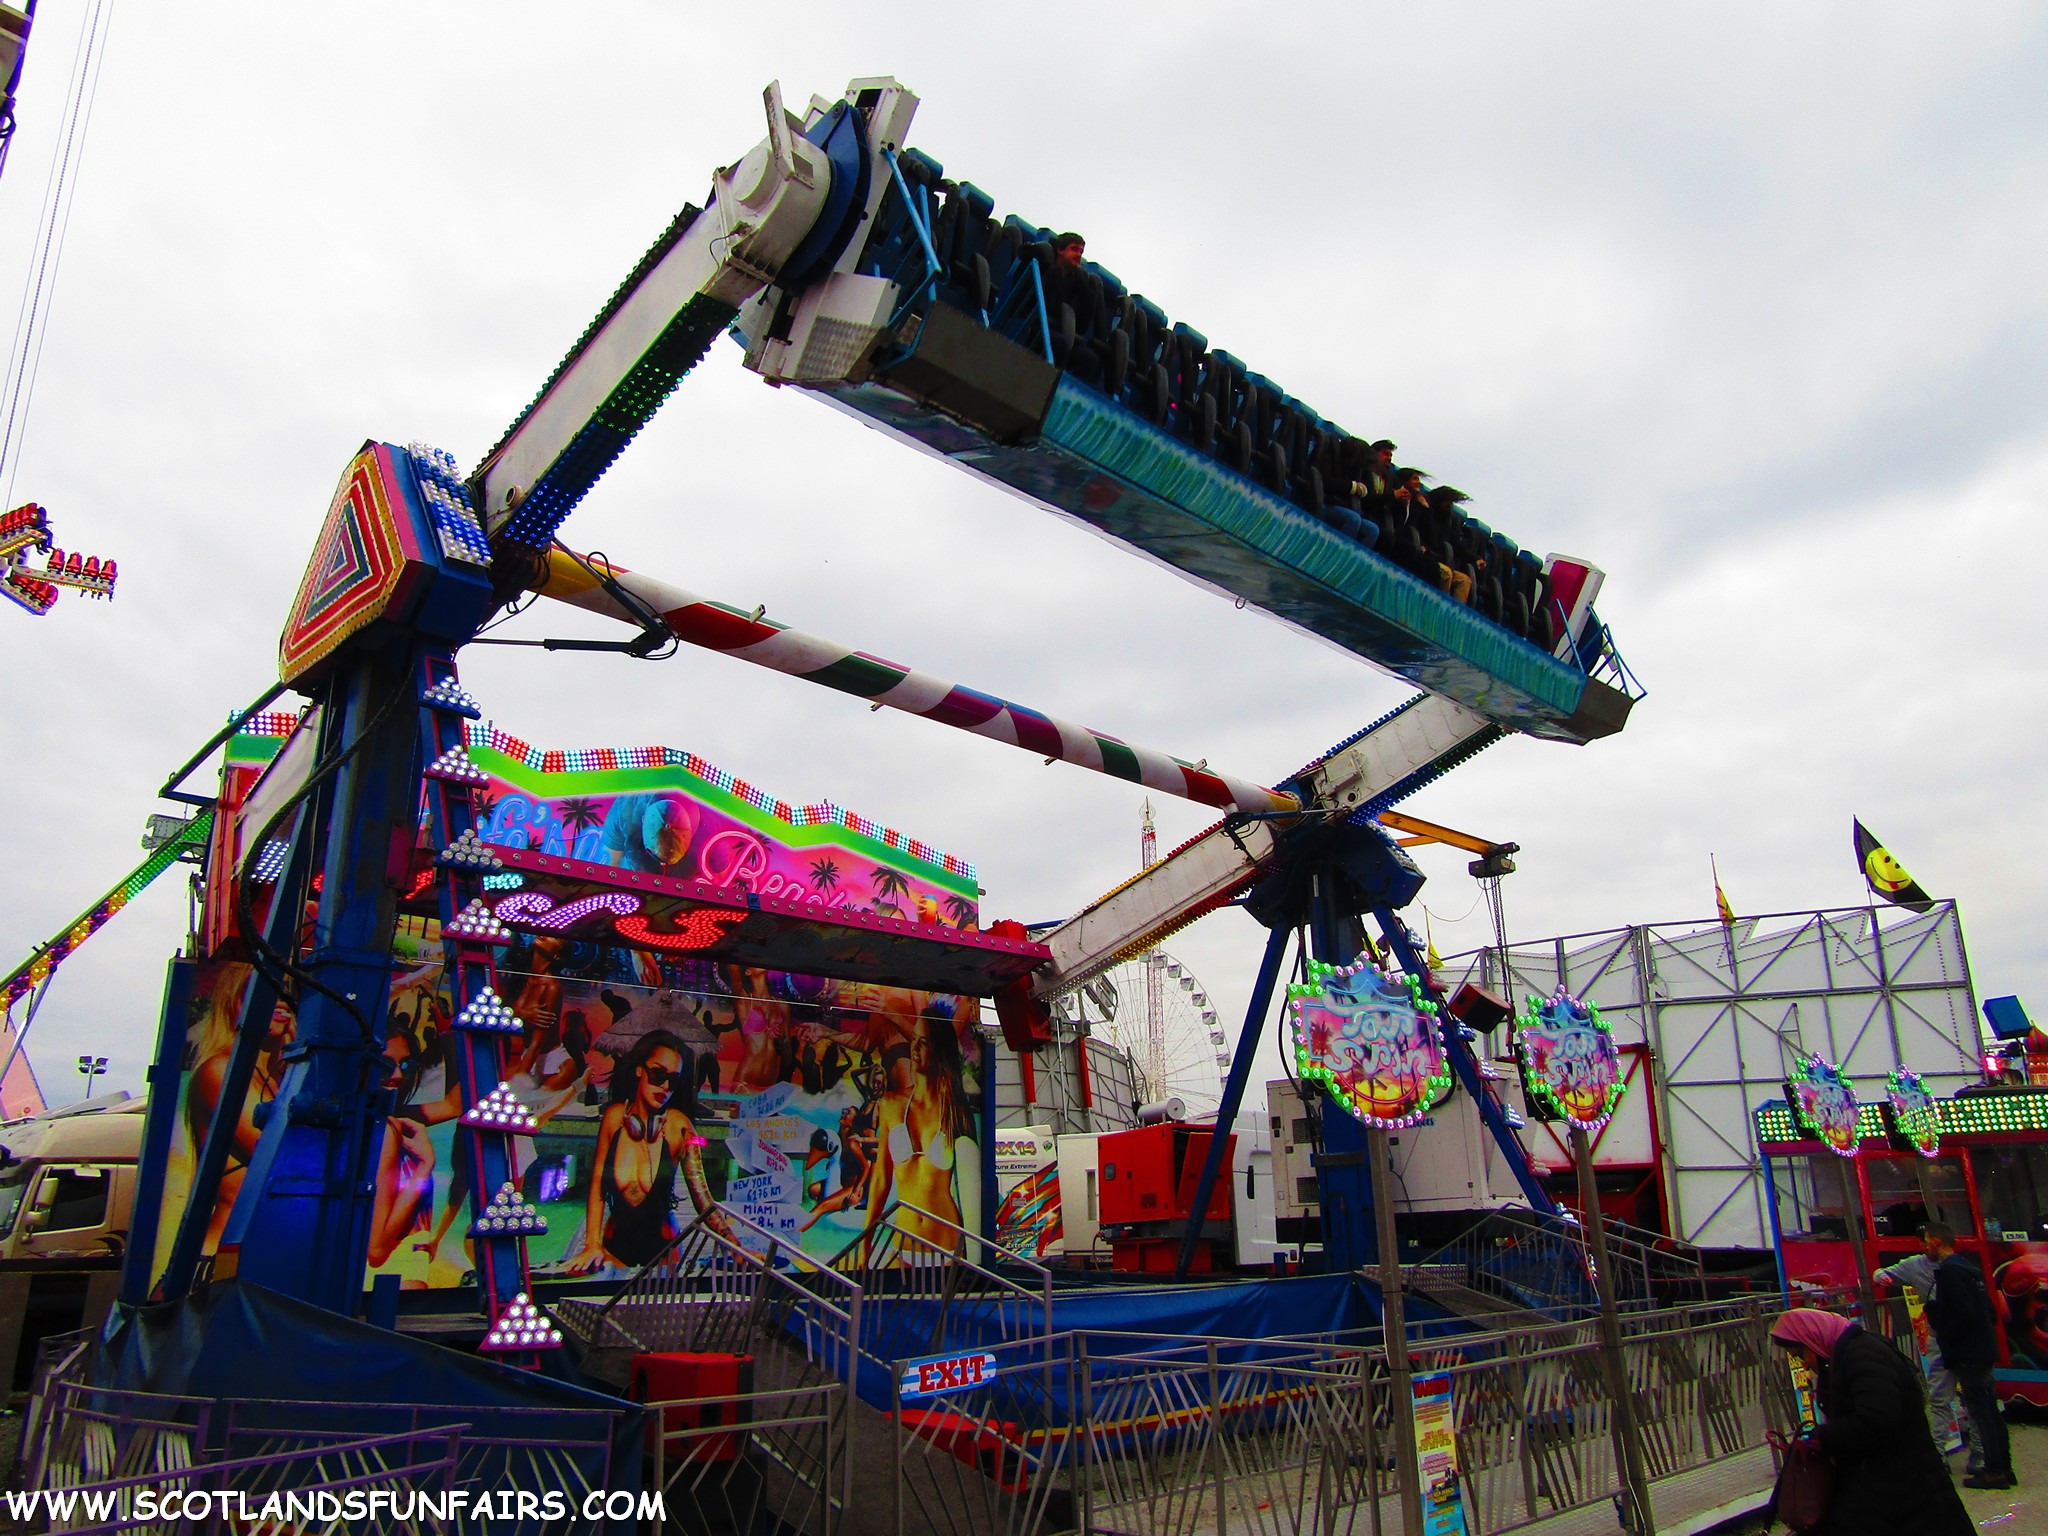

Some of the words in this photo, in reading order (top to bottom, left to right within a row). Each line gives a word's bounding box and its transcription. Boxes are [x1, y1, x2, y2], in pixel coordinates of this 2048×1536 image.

[746, 1119, 762, 1129] LOS
[733, 1178, 750, 1191] NEW
[752, 1175, 773, 1189] YORK
[770, 1185, 781, 1196] KM
[780, 1218, 795, 1229] KM
[918, 1354, 986, 1394] EXIT
